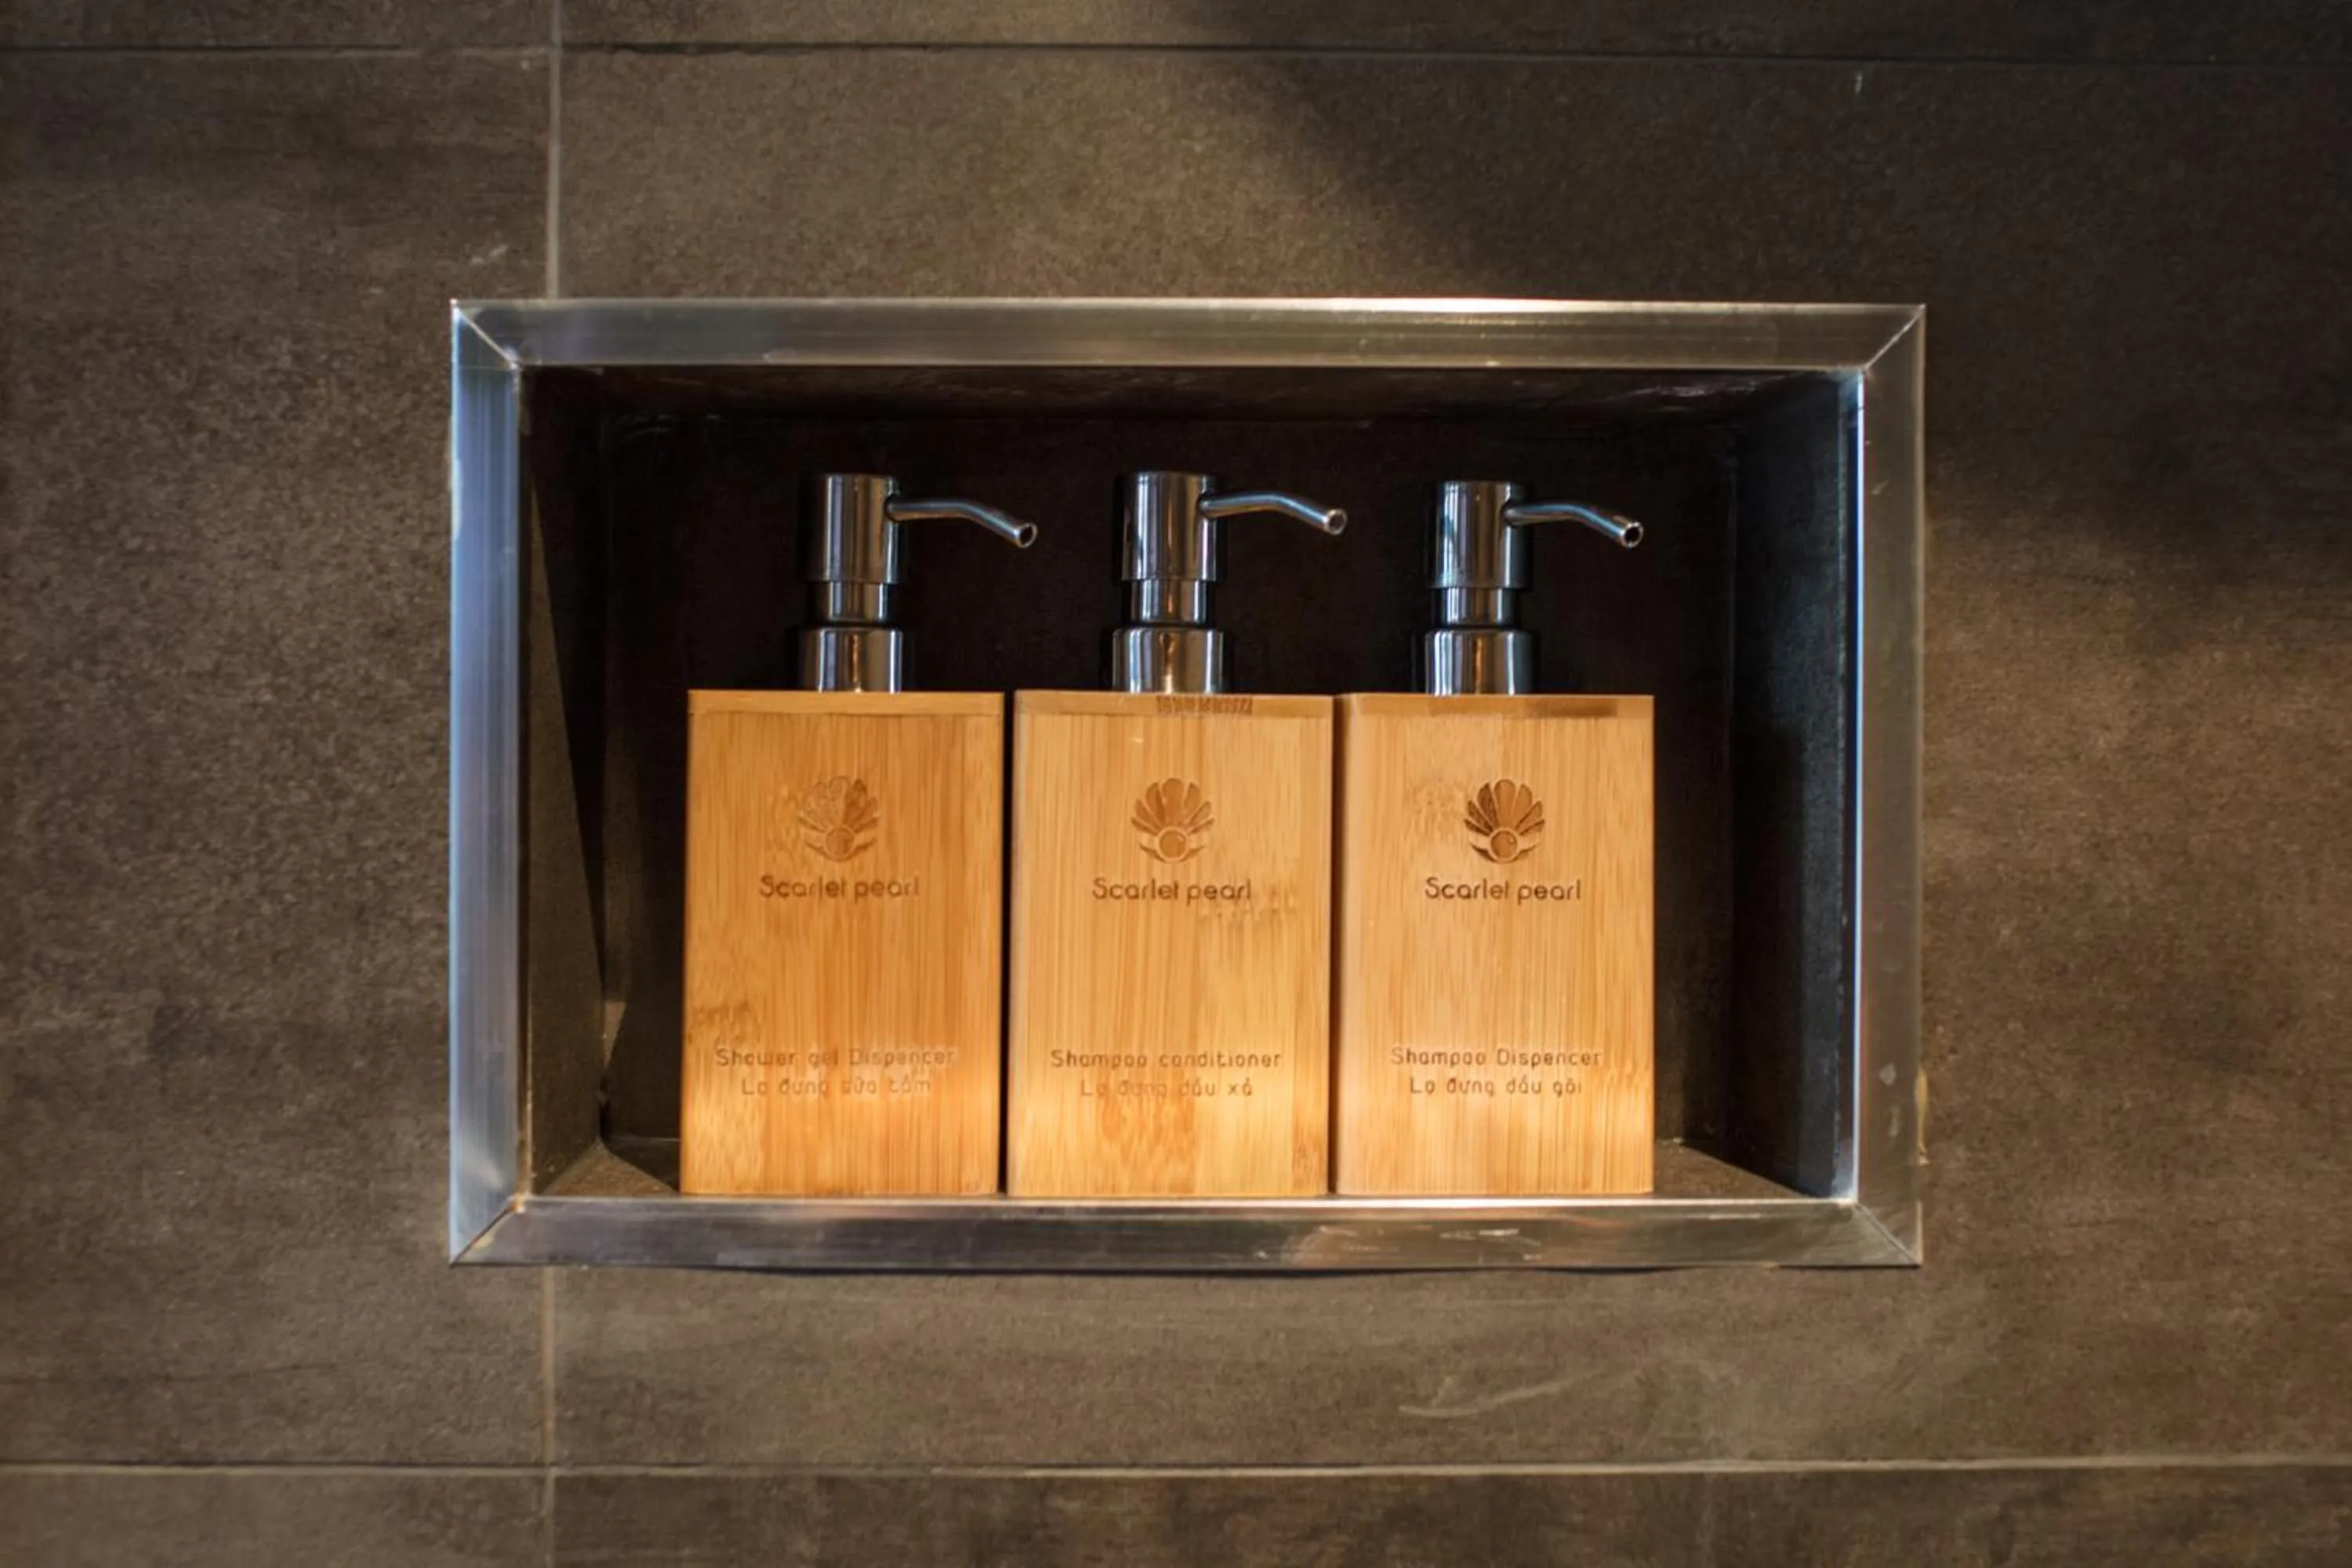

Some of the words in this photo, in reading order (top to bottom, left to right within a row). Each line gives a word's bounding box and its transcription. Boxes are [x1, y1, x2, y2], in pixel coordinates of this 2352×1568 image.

[758, 873, 847, 898] Scarlet
[854, 875, 920, 904] pearl
[1091, 877, 1179, 901] Scarlet
[1186, 878, 1252, 906] pearl
[1425, 876, 1509, 901] Scarlet
[1517, 878, 1581, 906] pearl
[716, 1047, 797, 1066] Shower
[808, 1047, 838, 1069] gel
[1050, 1048, 1148, 1070] Shampoo
[1159, 1050, 1281, 1069] conditioner
[1391, 1046, 1486, 1069] Shampoo
[1497, 1047, 1603, 1070] Dispencer
